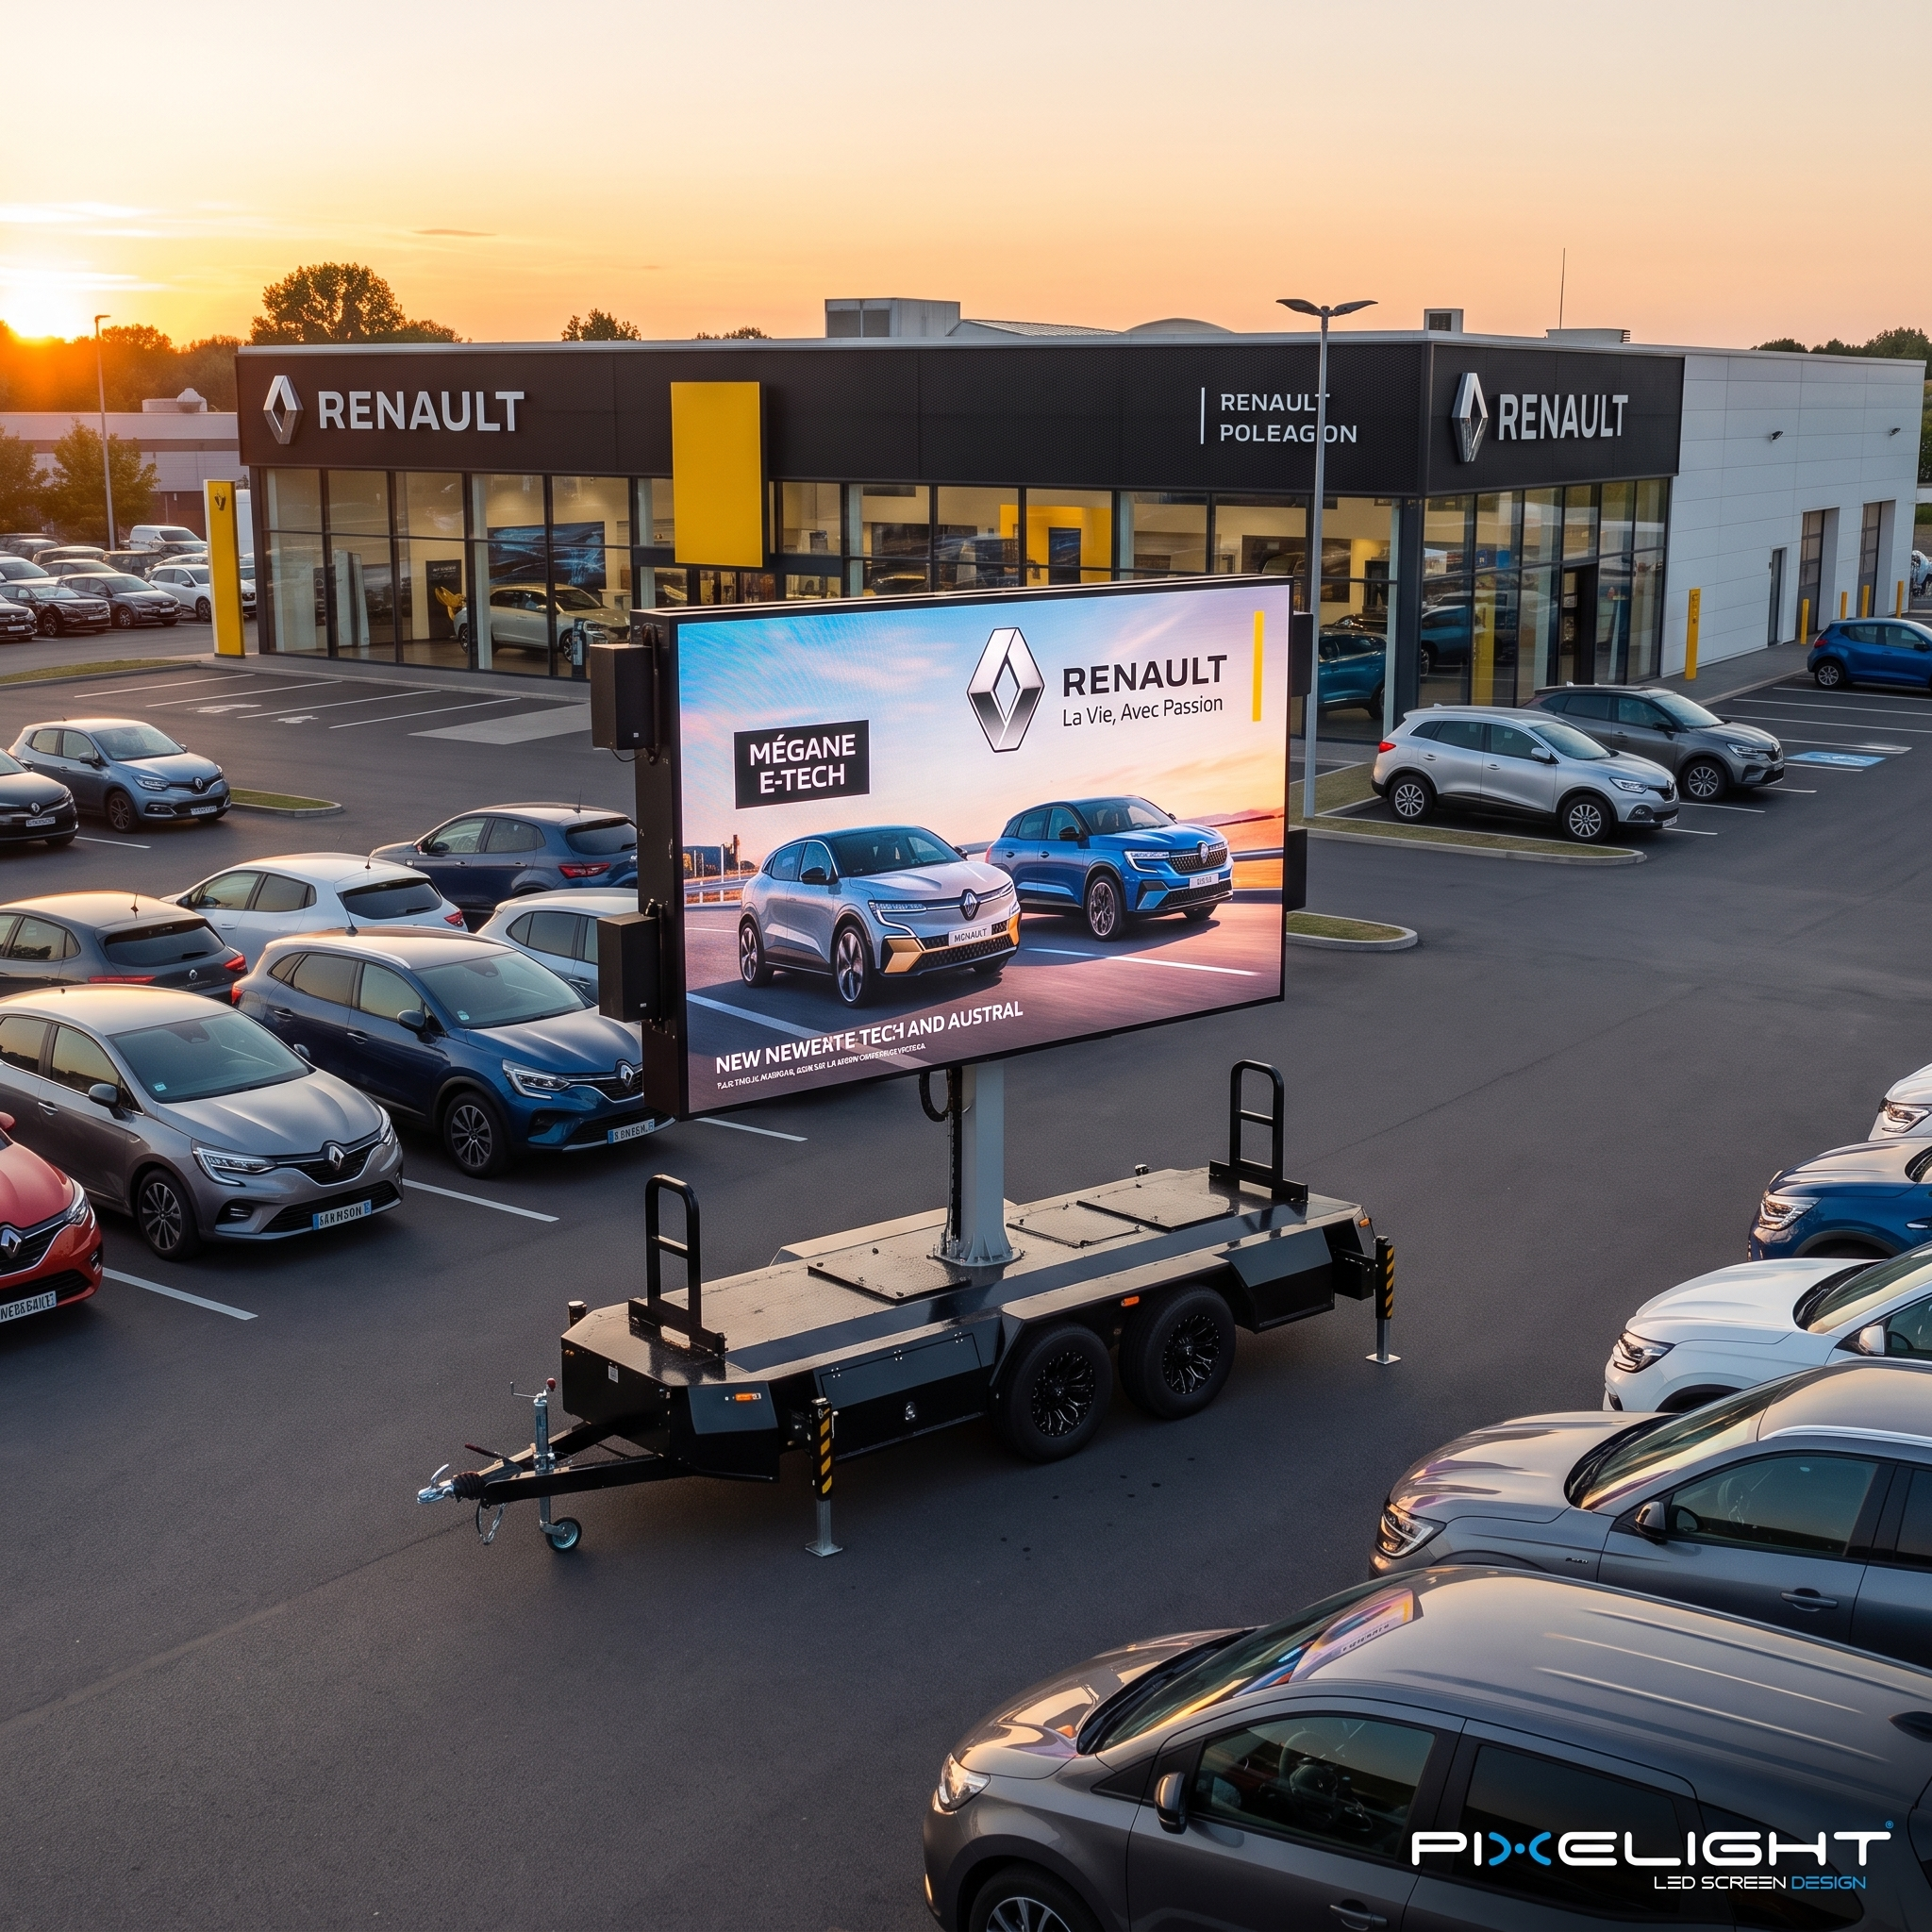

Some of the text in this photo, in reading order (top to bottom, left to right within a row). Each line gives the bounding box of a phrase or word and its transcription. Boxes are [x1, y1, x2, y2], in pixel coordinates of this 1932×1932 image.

[318, 391, 525, 432] RENAULT
[1498, 393, 1629, 441] RENAULT
[1063, 654, 1227, 698] RENAULT
[1063, 695, 1223, 726] La Vie, Avec Passion
[749, 733, 856, 766] MÉGANE
[759, 763, 845, 794] E-TECH
[716, 1049, 761, 1074] NEW
[907, 1016, 945, 1038] AND
[947, 1001, 1024, 1029] AUSTRAL
